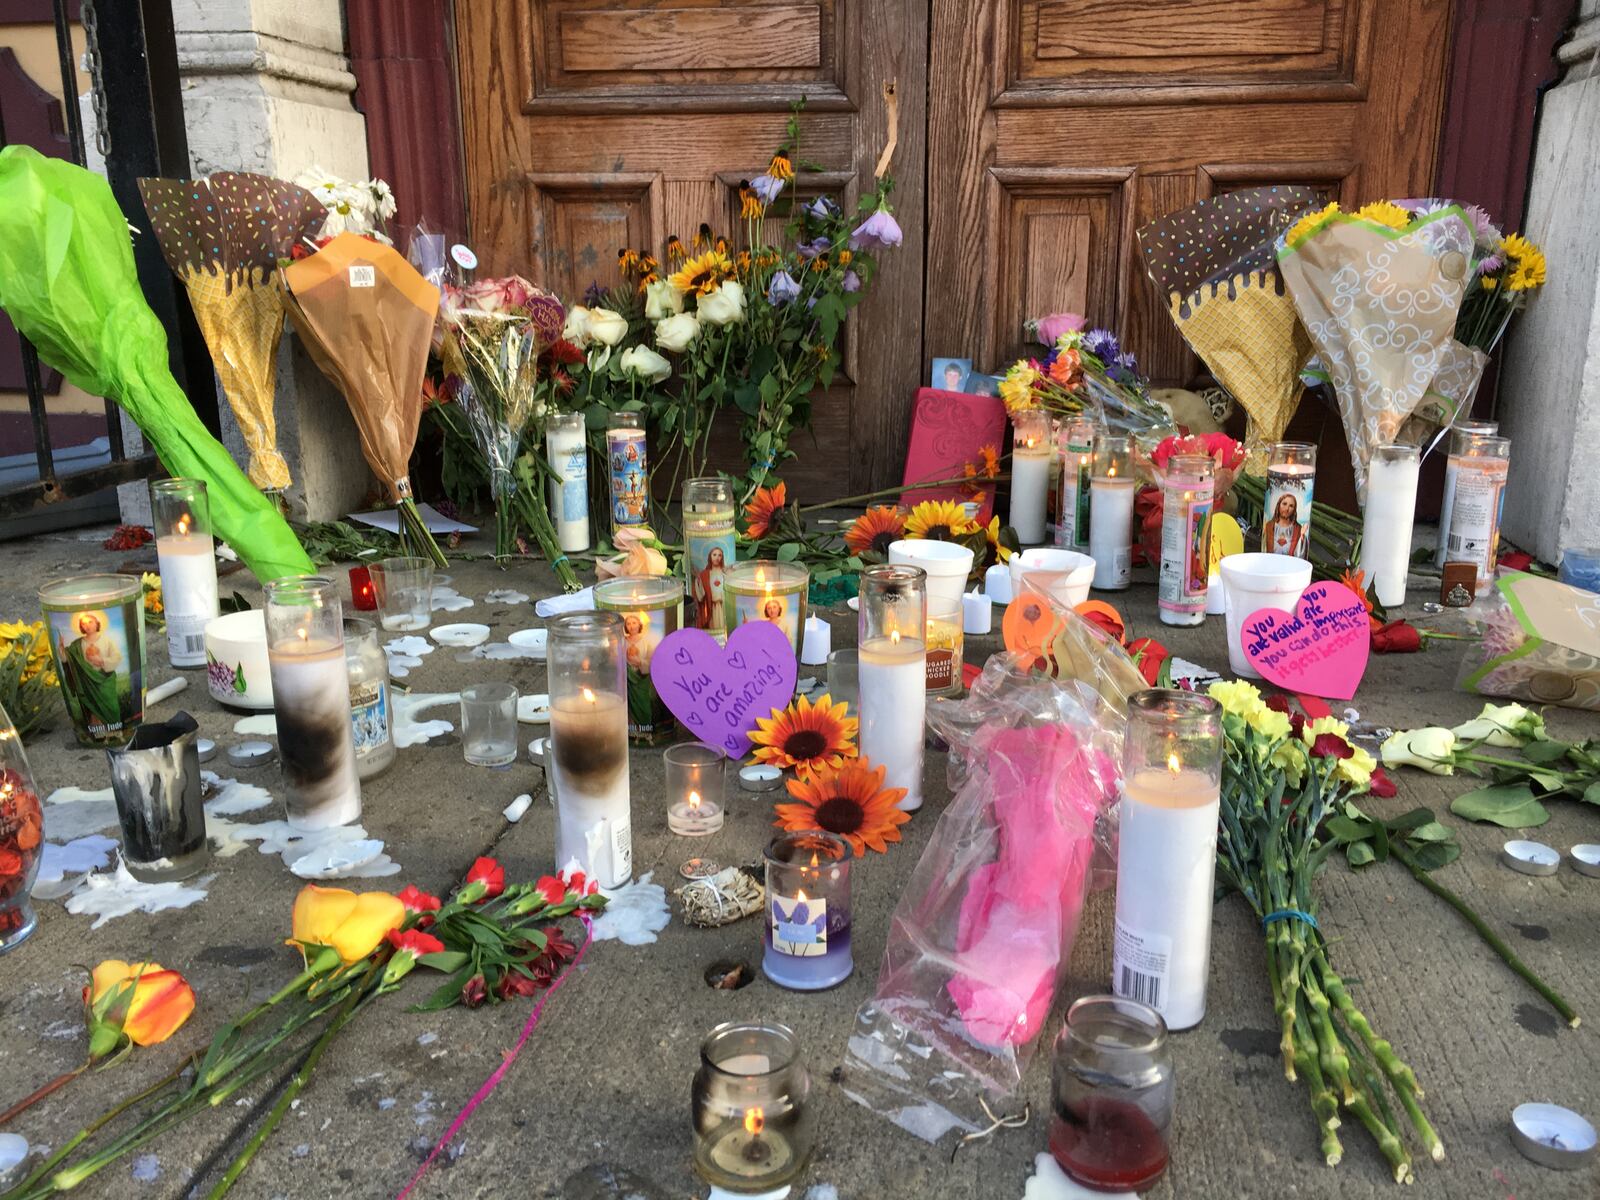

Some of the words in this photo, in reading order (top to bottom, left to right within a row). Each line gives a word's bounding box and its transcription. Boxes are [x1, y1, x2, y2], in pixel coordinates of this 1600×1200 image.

[1288, 638, 1313, 652] can
[1311, 627, 1329, 642] do
[926, 659, 950, 668] UGARED
[927, 665, 950, 674] NICKER
[925, 671, 949, 679] OODLE
[672, 673, 712, 702] You
[725, 648, 784, 728] amazing!
[706, 683, 733, 713] are
[88, 724, 106, 733] Saint
[107, 721, 123, 732] Jude
